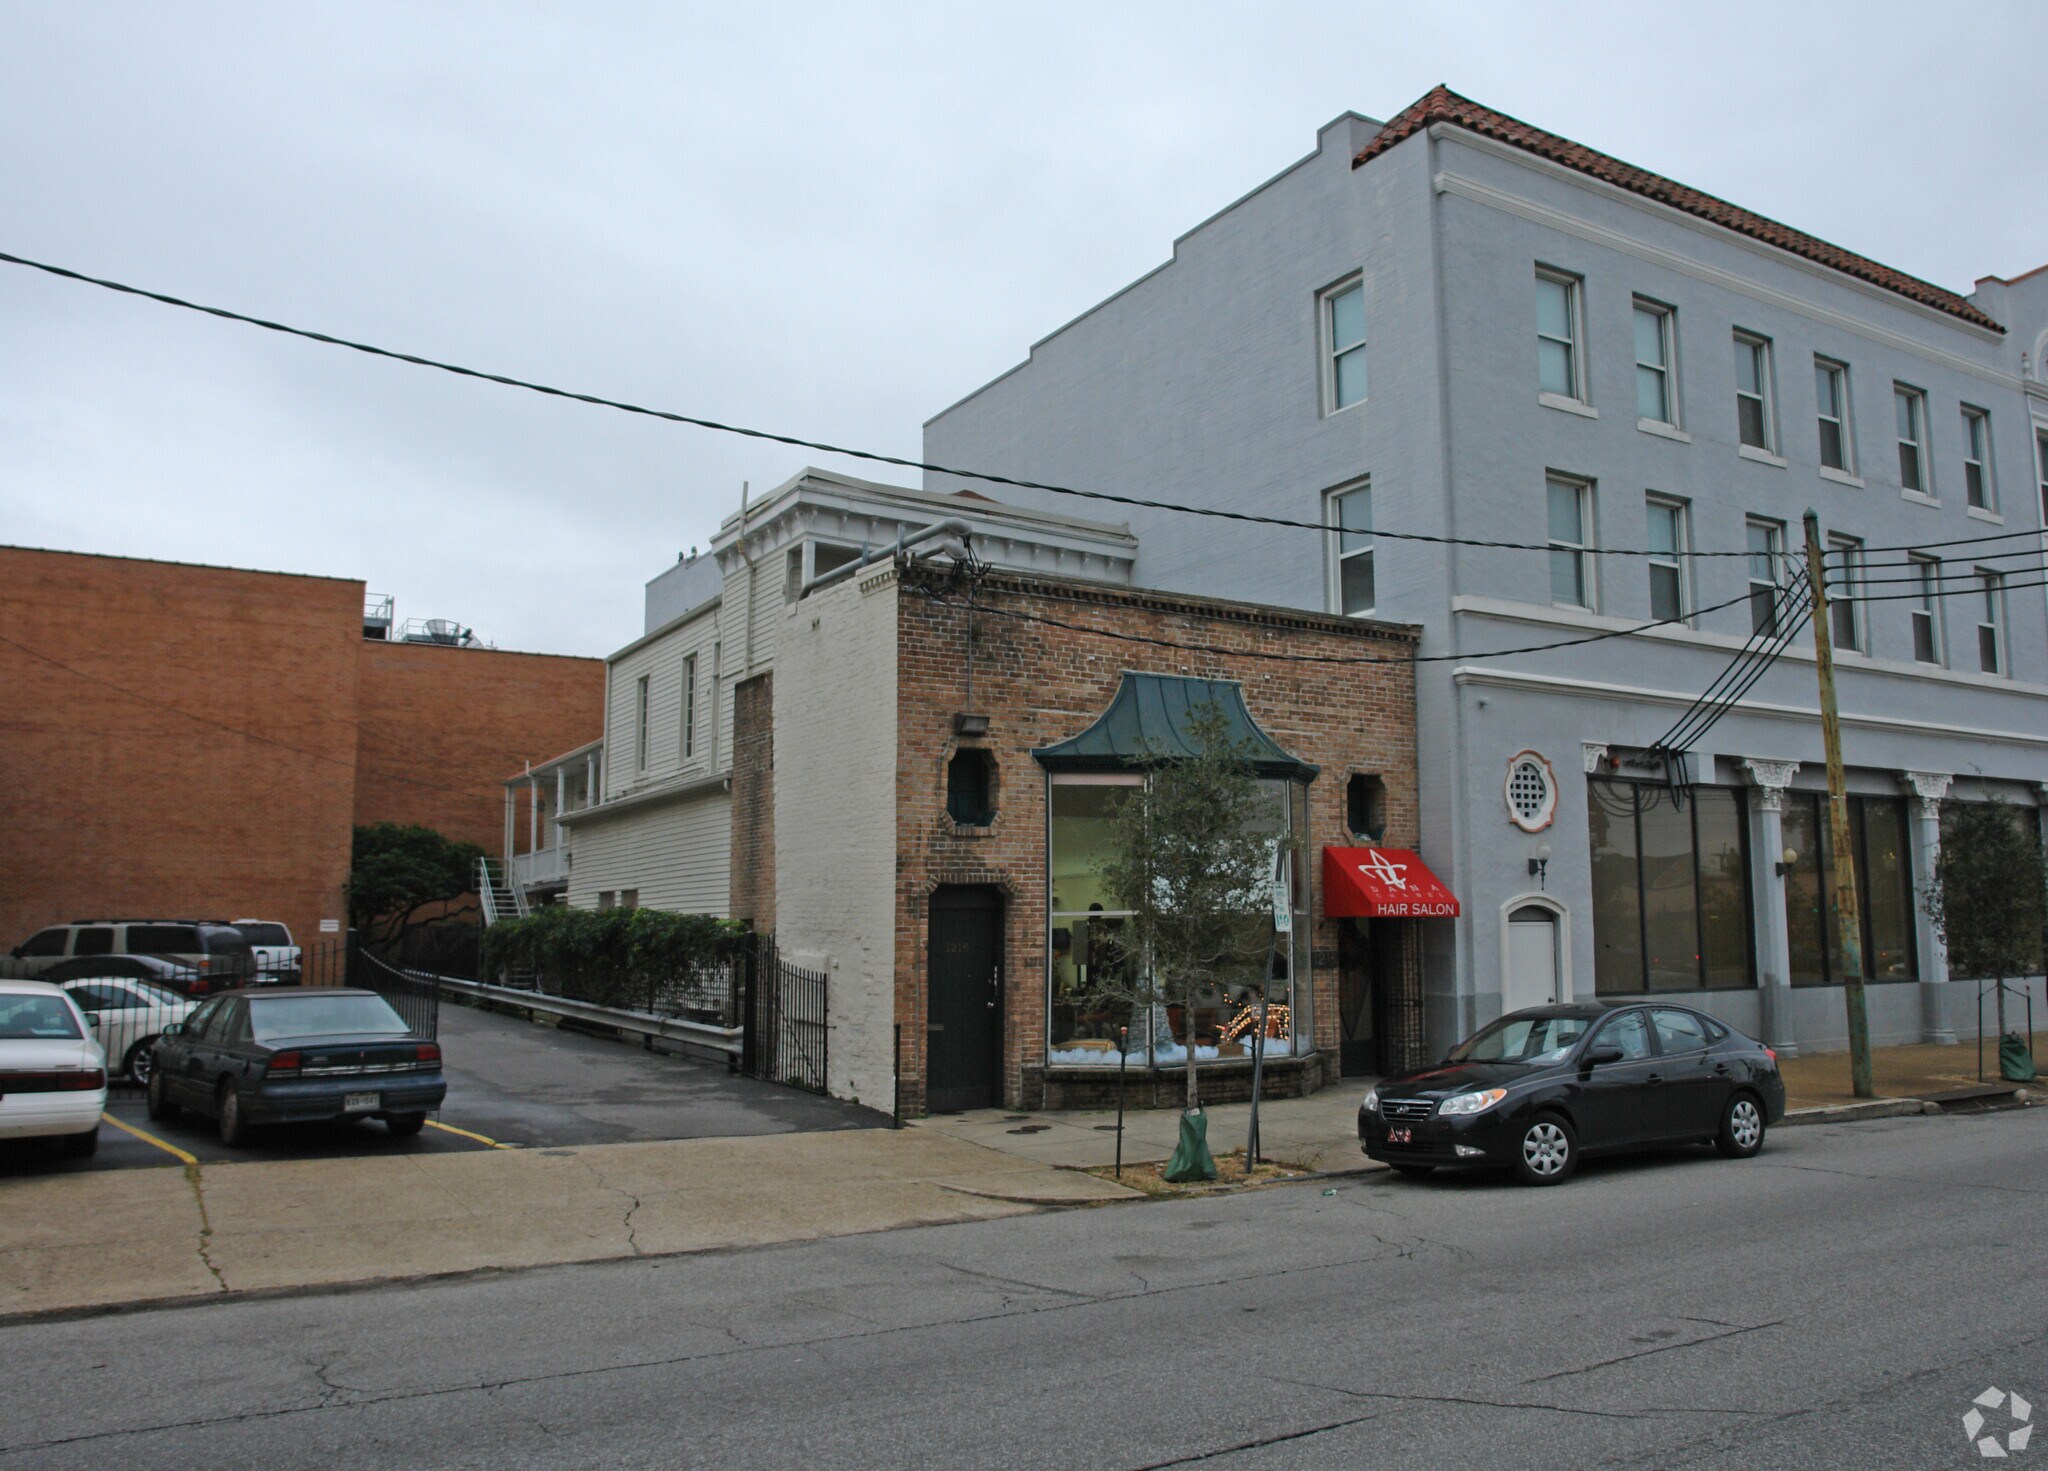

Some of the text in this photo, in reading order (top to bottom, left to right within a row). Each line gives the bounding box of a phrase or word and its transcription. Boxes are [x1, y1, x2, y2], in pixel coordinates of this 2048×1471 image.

[1370, 884, 1440, 893] DANA
[1377, 903, 1455, 915] HAIR SALON
